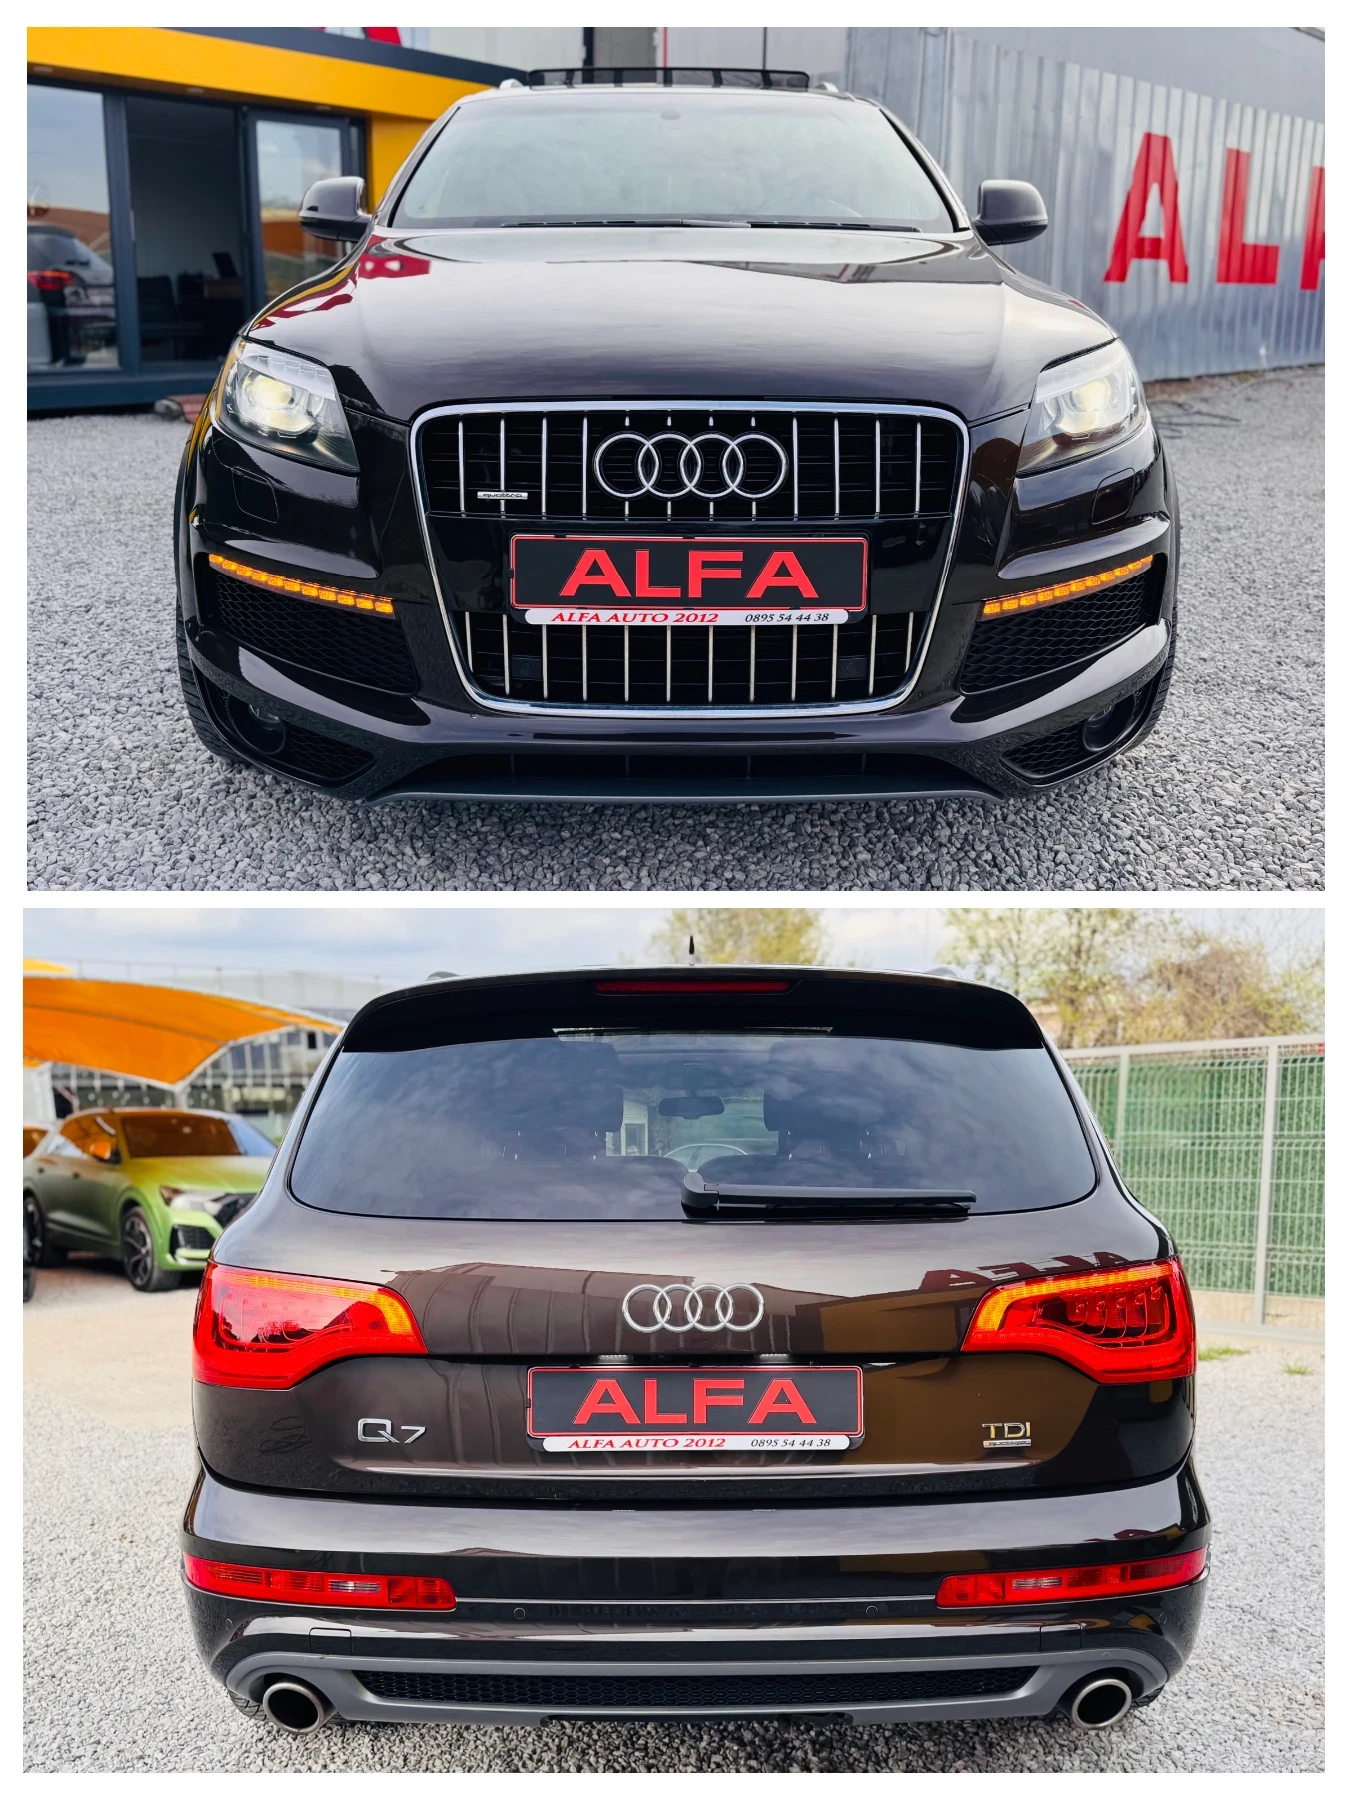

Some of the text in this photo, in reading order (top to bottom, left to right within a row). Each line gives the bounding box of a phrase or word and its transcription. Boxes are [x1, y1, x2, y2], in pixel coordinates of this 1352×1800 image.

[559, 548, 819, 598] ALFA
[551, 612, 829, 623] ALFA AUTO 2012 0895 54 44 38
[573, 1378, 818, 1424] ALFA
[358, 1418, 426, 1443] Q7
[982, 1421, 1031, 1439] TDI
[568, 1438, 832, 1449] ALFA AUTO 2012 0895 54 44 38
